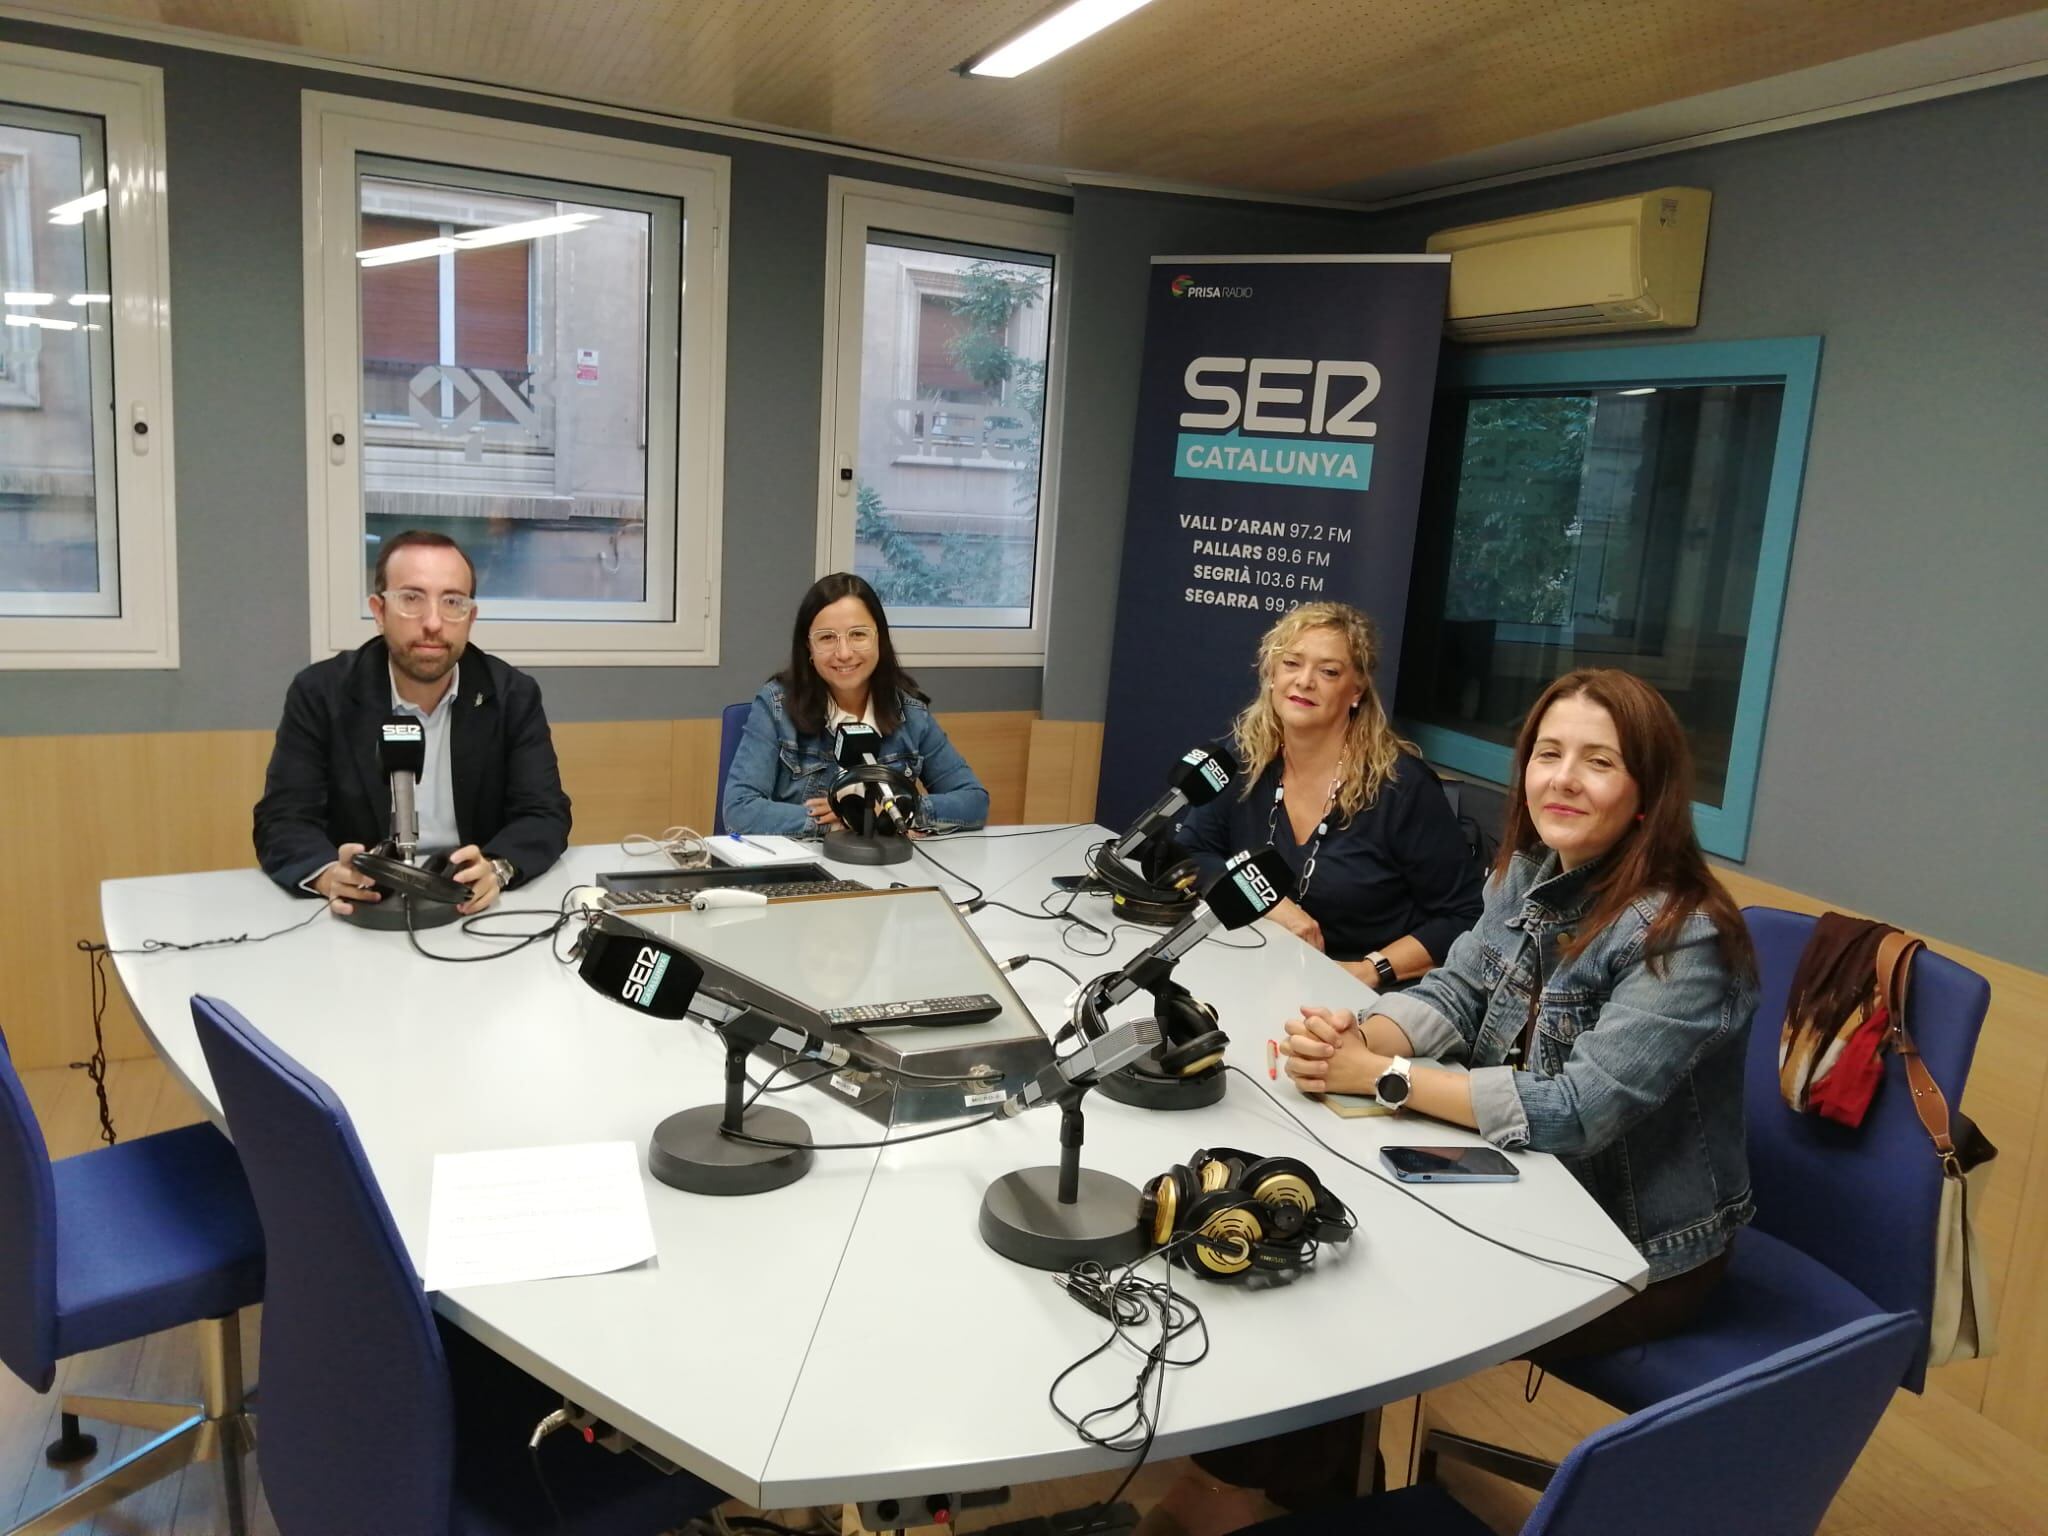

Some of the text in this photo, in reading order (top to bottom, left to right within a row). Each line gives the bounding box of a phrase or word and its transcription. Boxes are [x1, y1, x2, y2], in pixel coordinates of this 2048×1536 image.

[1187, 286, 1221, 299] PRISA
[1179, 356, 1382, 438] SER
[1185, 445, 1359, 480] CATALUNYA
[1179, 514, 1217, 531] VALL
[1289, 523, 1324, 541] 97.2
[1327, 527, 1352, 544] FM
[1192, 540, 1331, 567] PALLARS 89.6 FM
[1193, 564, 1325, 593] SEGRIÀ 103.6 FM
[1184, 587, 1260, 611] SEGARRA
[382, 724, 421, 735] SER
[1204, 757, 1230, 788] SER
[1240, 862, 1278, 907] SER
[621, 945, 661, 1004] SER
